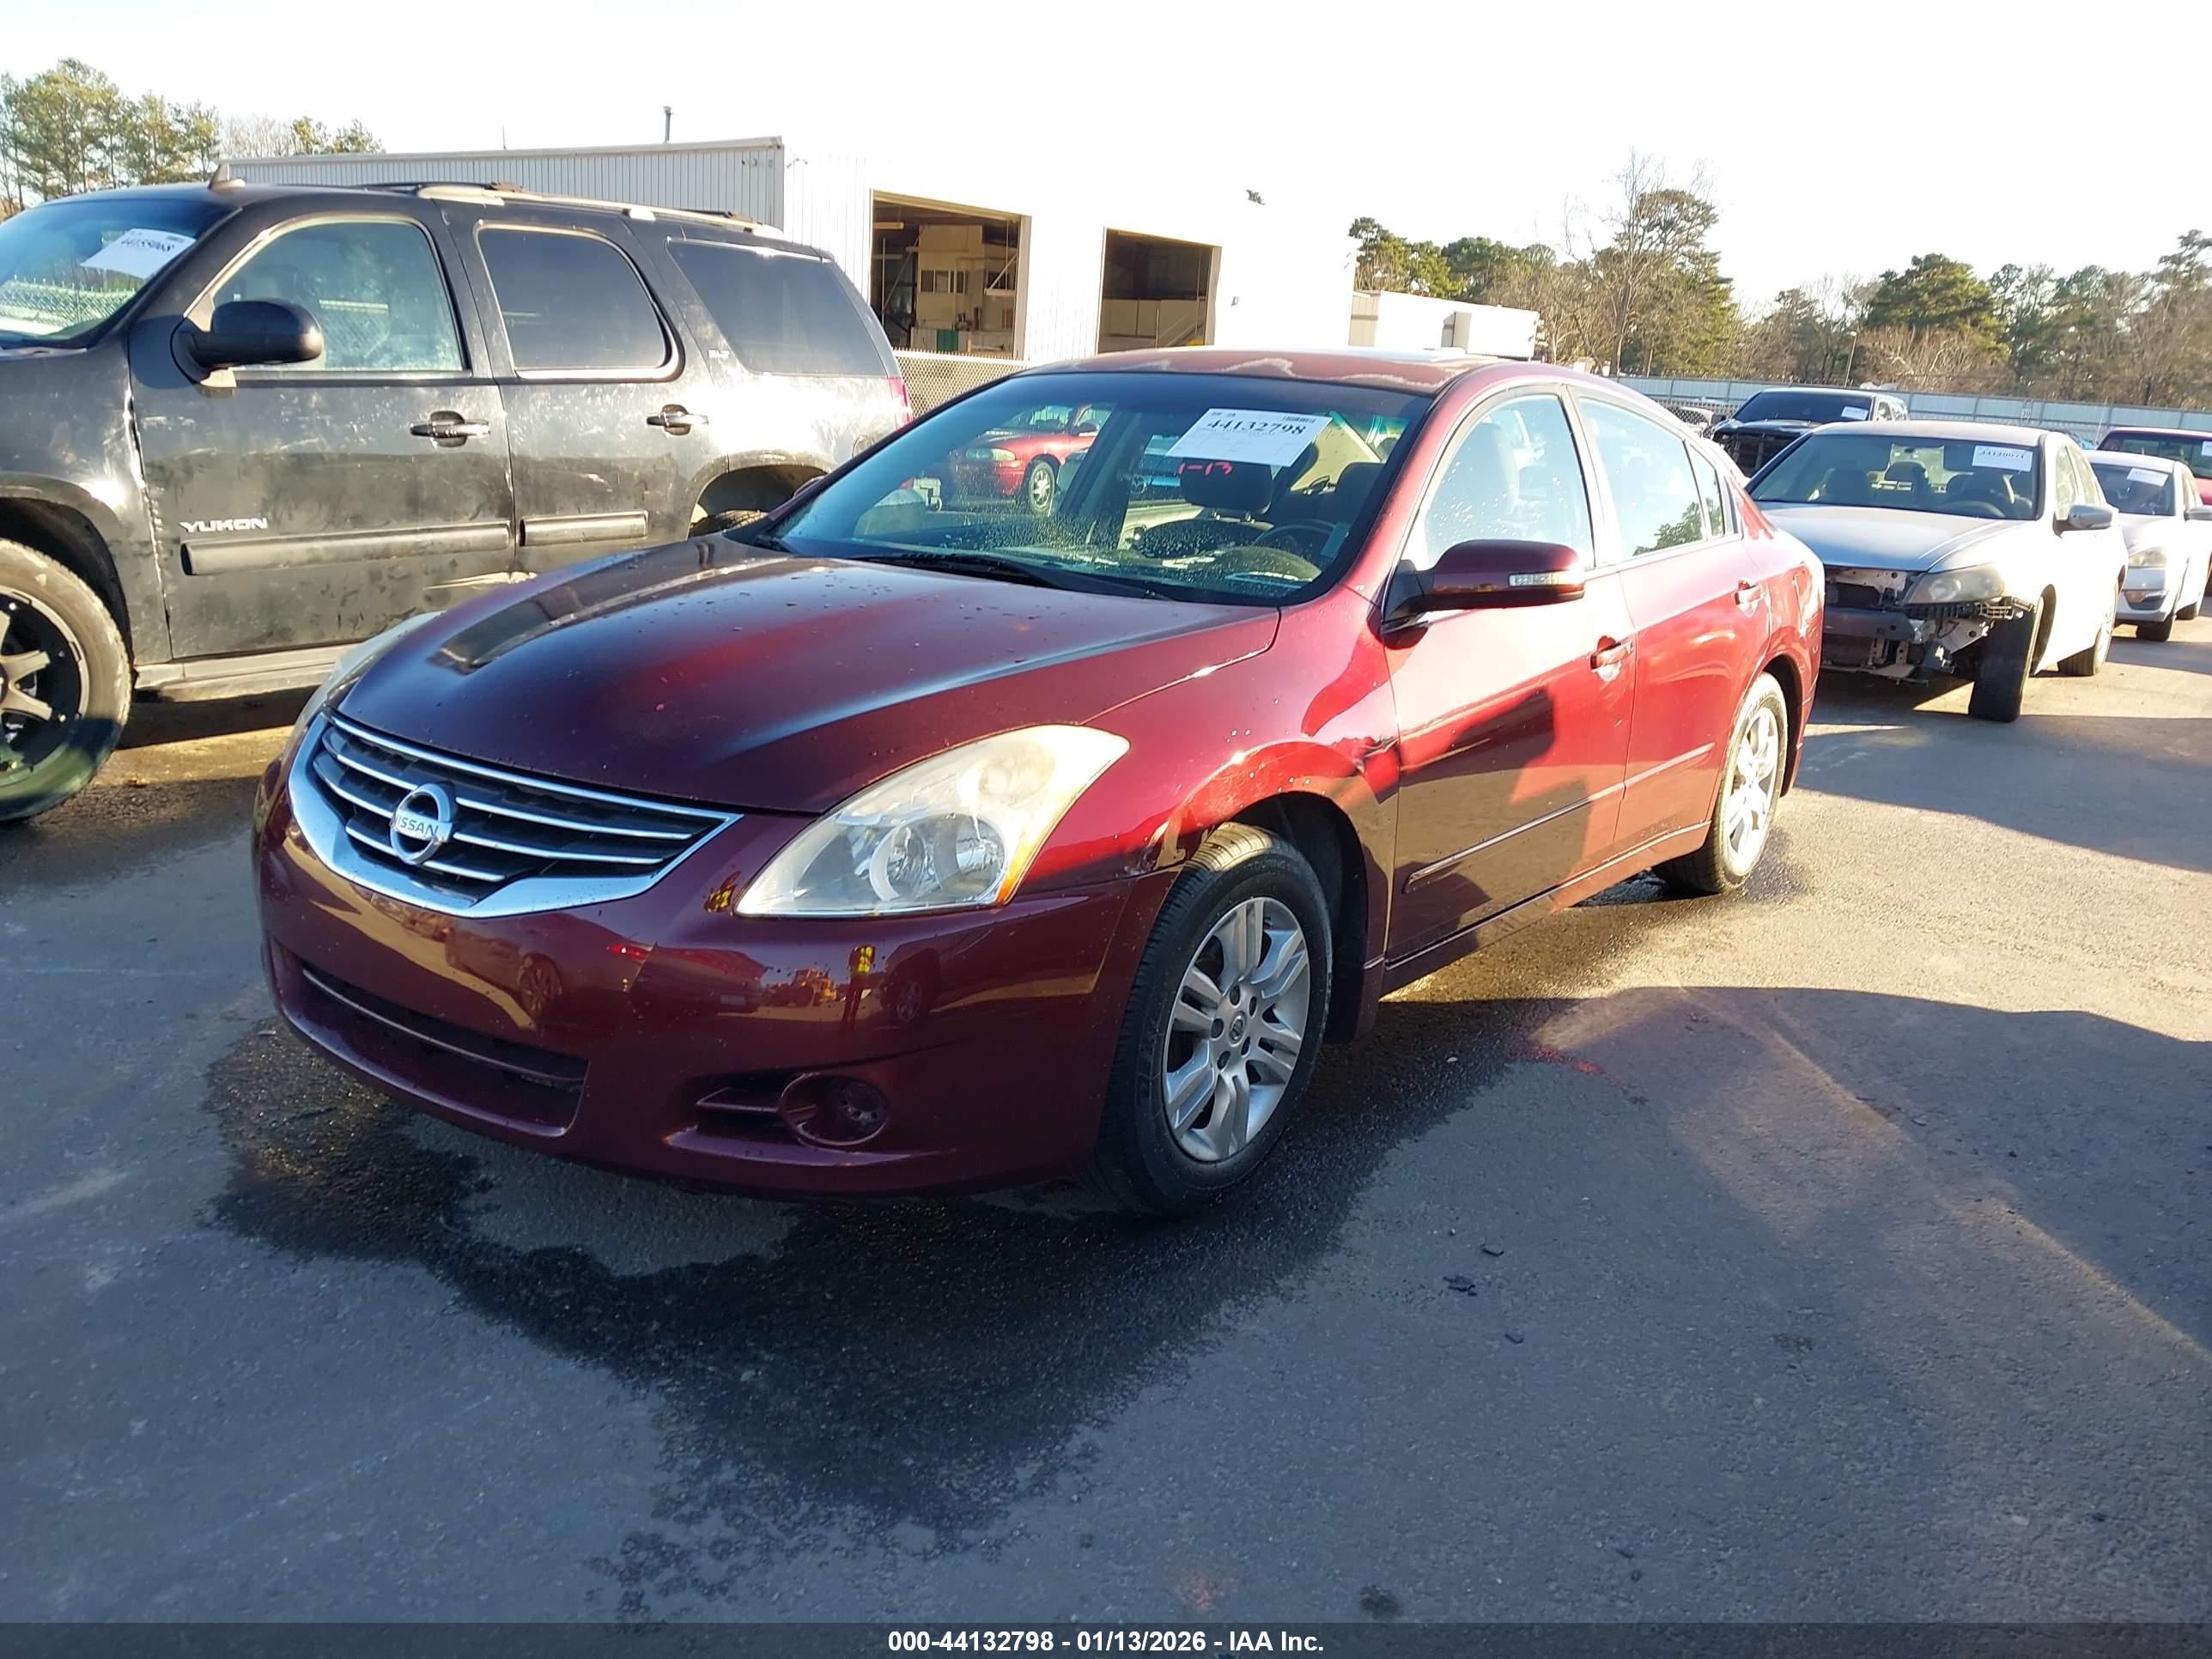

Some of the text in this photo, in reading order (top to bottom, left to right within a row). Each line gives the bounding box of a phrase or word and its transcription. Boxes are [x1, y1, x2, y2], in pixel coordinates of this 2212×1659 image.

[1206, 418, 1307, 435] 44132798
[1178, 461, 1233, 476] 1-13
[179, 518, 268, 532] YUKON
[396, 813, 439, 837] NISSAN
